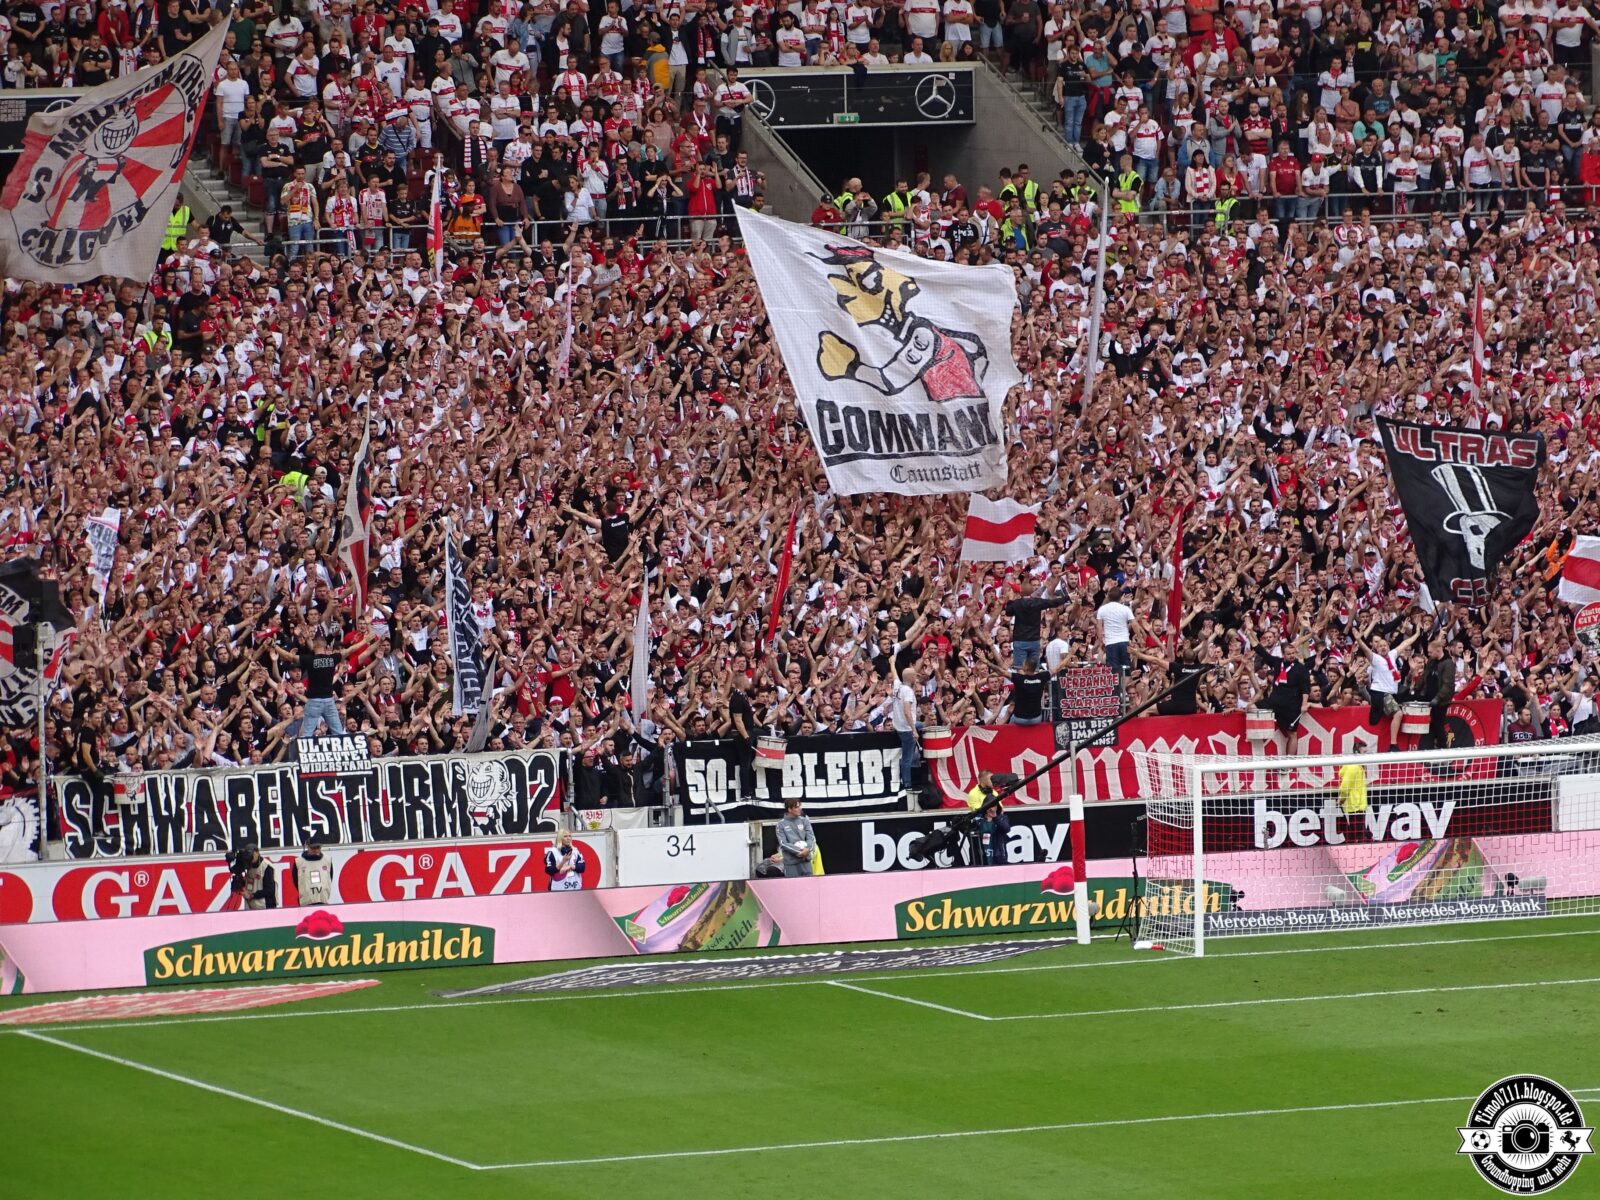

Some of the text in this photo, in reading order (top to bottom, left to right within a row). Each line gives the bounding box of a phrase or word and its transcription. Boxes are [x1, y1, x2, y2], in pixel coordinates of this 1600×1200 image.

[1386, 423, 1538, 469] ULTRAS
[889, 460, 982, 484] Cannstatt
[1060, 674, 1119, 688] VERBANNTE
[1066, 686, 1114, 698] KEHRT
[1071, 719, 1113, 729] DU BIST
[1071, 729, 1114, 739] IMMR
[297, 735, 367, 753] ULTRAS
[299, 749, 368, 763] BEDEUTET
[300, 760, 372, 773] WIDERSTAND
[934, 711, 1379, 806] Commando
[781, 748, 903, 799] BLEIBT
[63, 752, 561, 859] SCHWABENSTURM 02
[666, 835, 695, 856] 34
[311, 887, 322, 895] TV
[905, 883, 1220, 932] Schwarzwldmilch
[1209, 898, 1541, 930] Mercedes-Benz Bank Mercedes-Benz Bank
[154, 927, 484, 979] Schwarzwaldmilch
